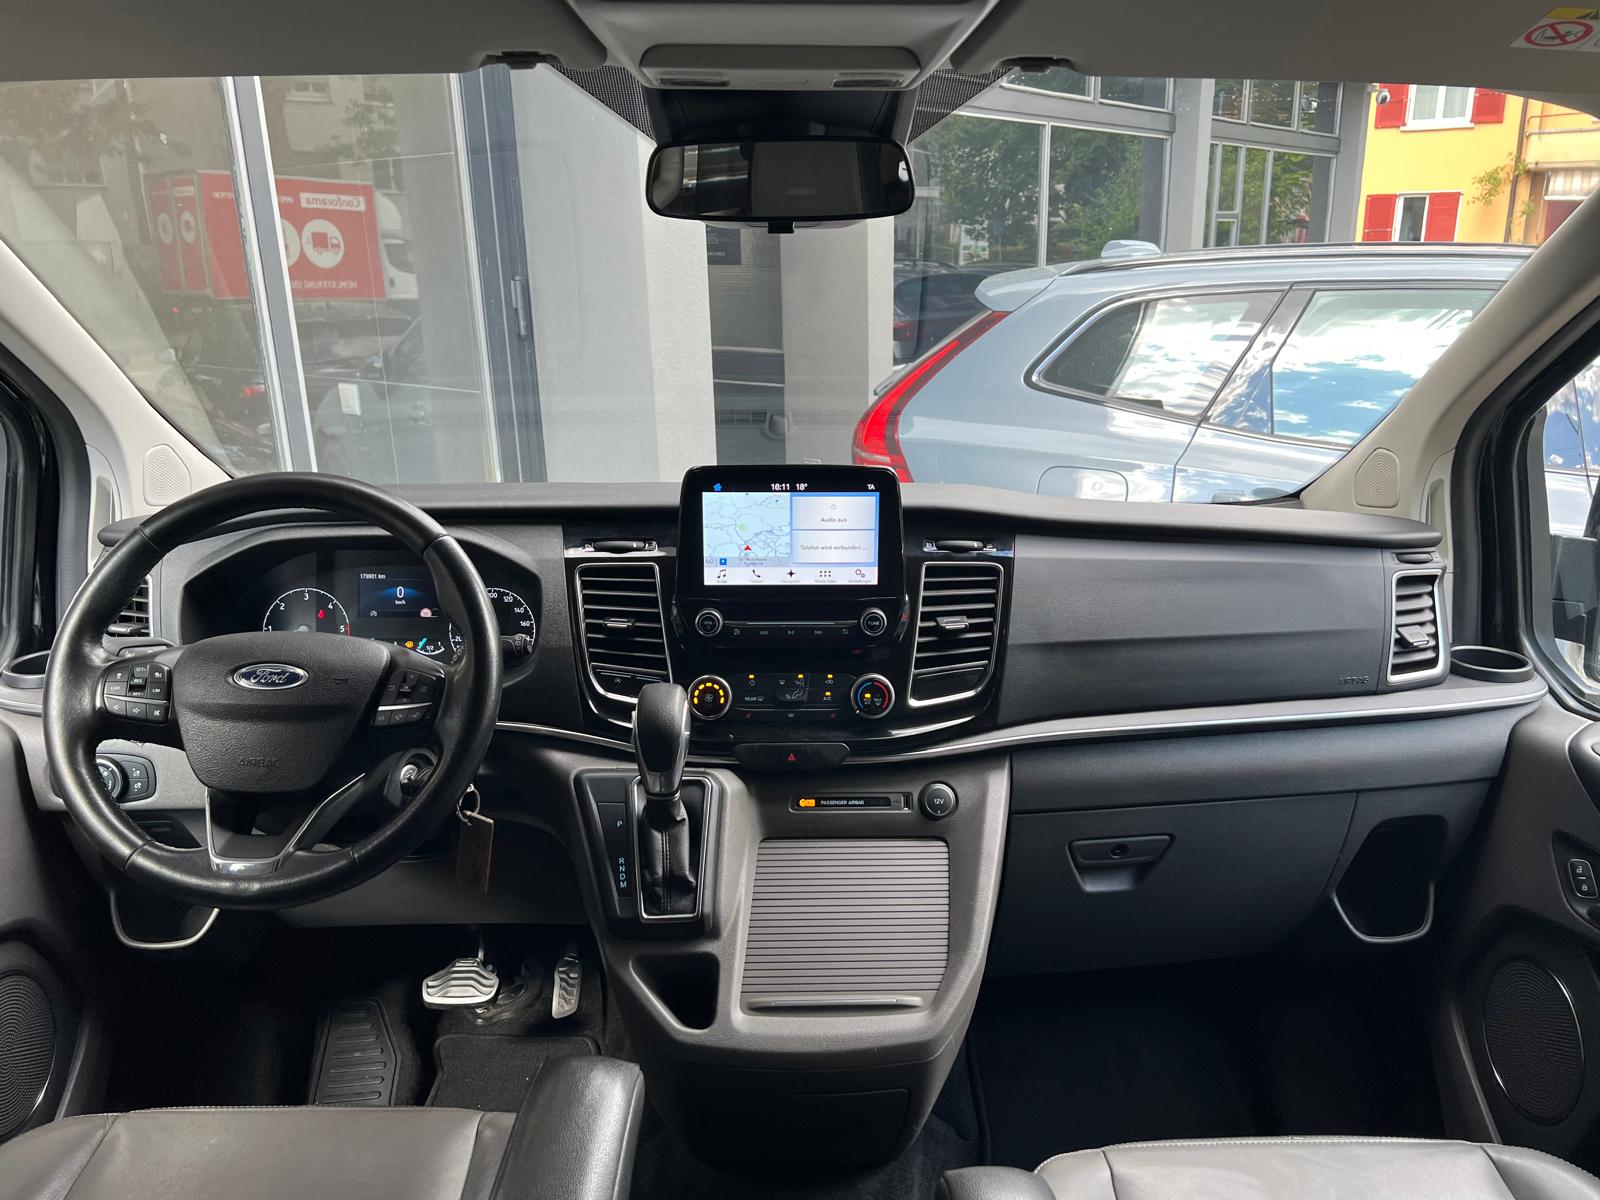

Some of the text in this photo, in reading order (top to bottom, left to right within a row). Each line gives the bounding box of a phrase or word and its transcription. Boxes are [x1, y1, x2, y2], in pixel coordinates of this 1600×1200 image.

[770, 483, 790, 491] 16:11
[304, 592, 309, 600] 3
[396, 586, 404, 598] 0
[280, 602, 285, 610] 2
[327, 602, 333, 610] 4
[250, 668, 288, 684] Ford
[1338, 675, 1369, 685] AIRBAG
[616, 820, 623, 828] P
